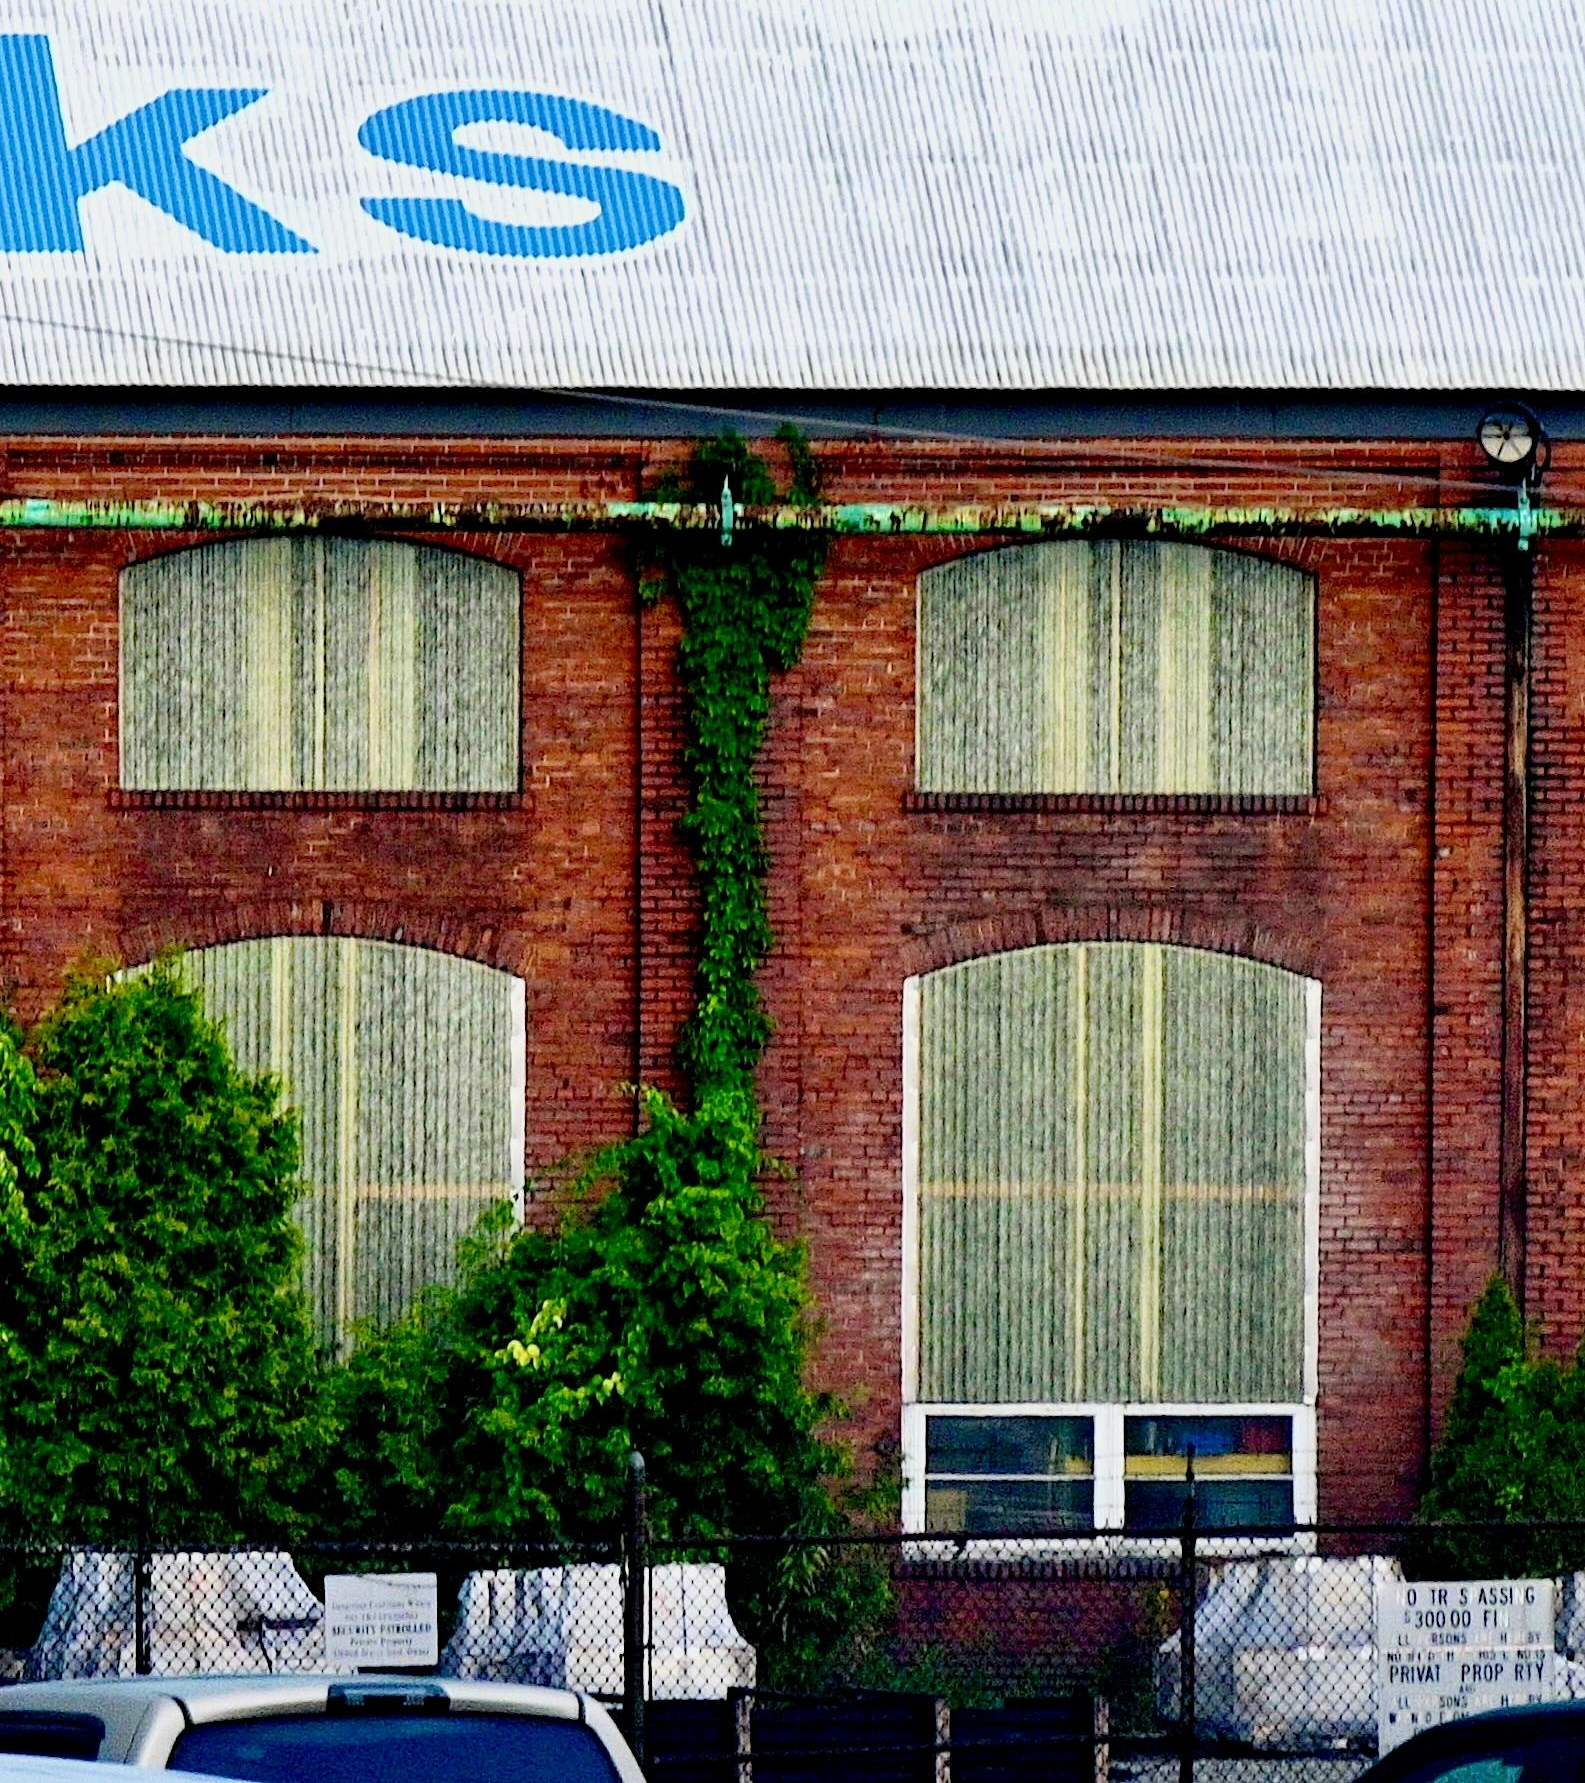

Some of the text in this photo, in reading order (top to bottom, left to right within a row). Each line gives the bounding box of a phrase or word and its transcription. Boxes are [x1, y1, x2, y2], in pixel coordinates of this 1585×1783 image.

[1483, 1609, 1510, 1628] FIN
[1389, 1662, 1544, 1684] PRIVAT PROPRTY
